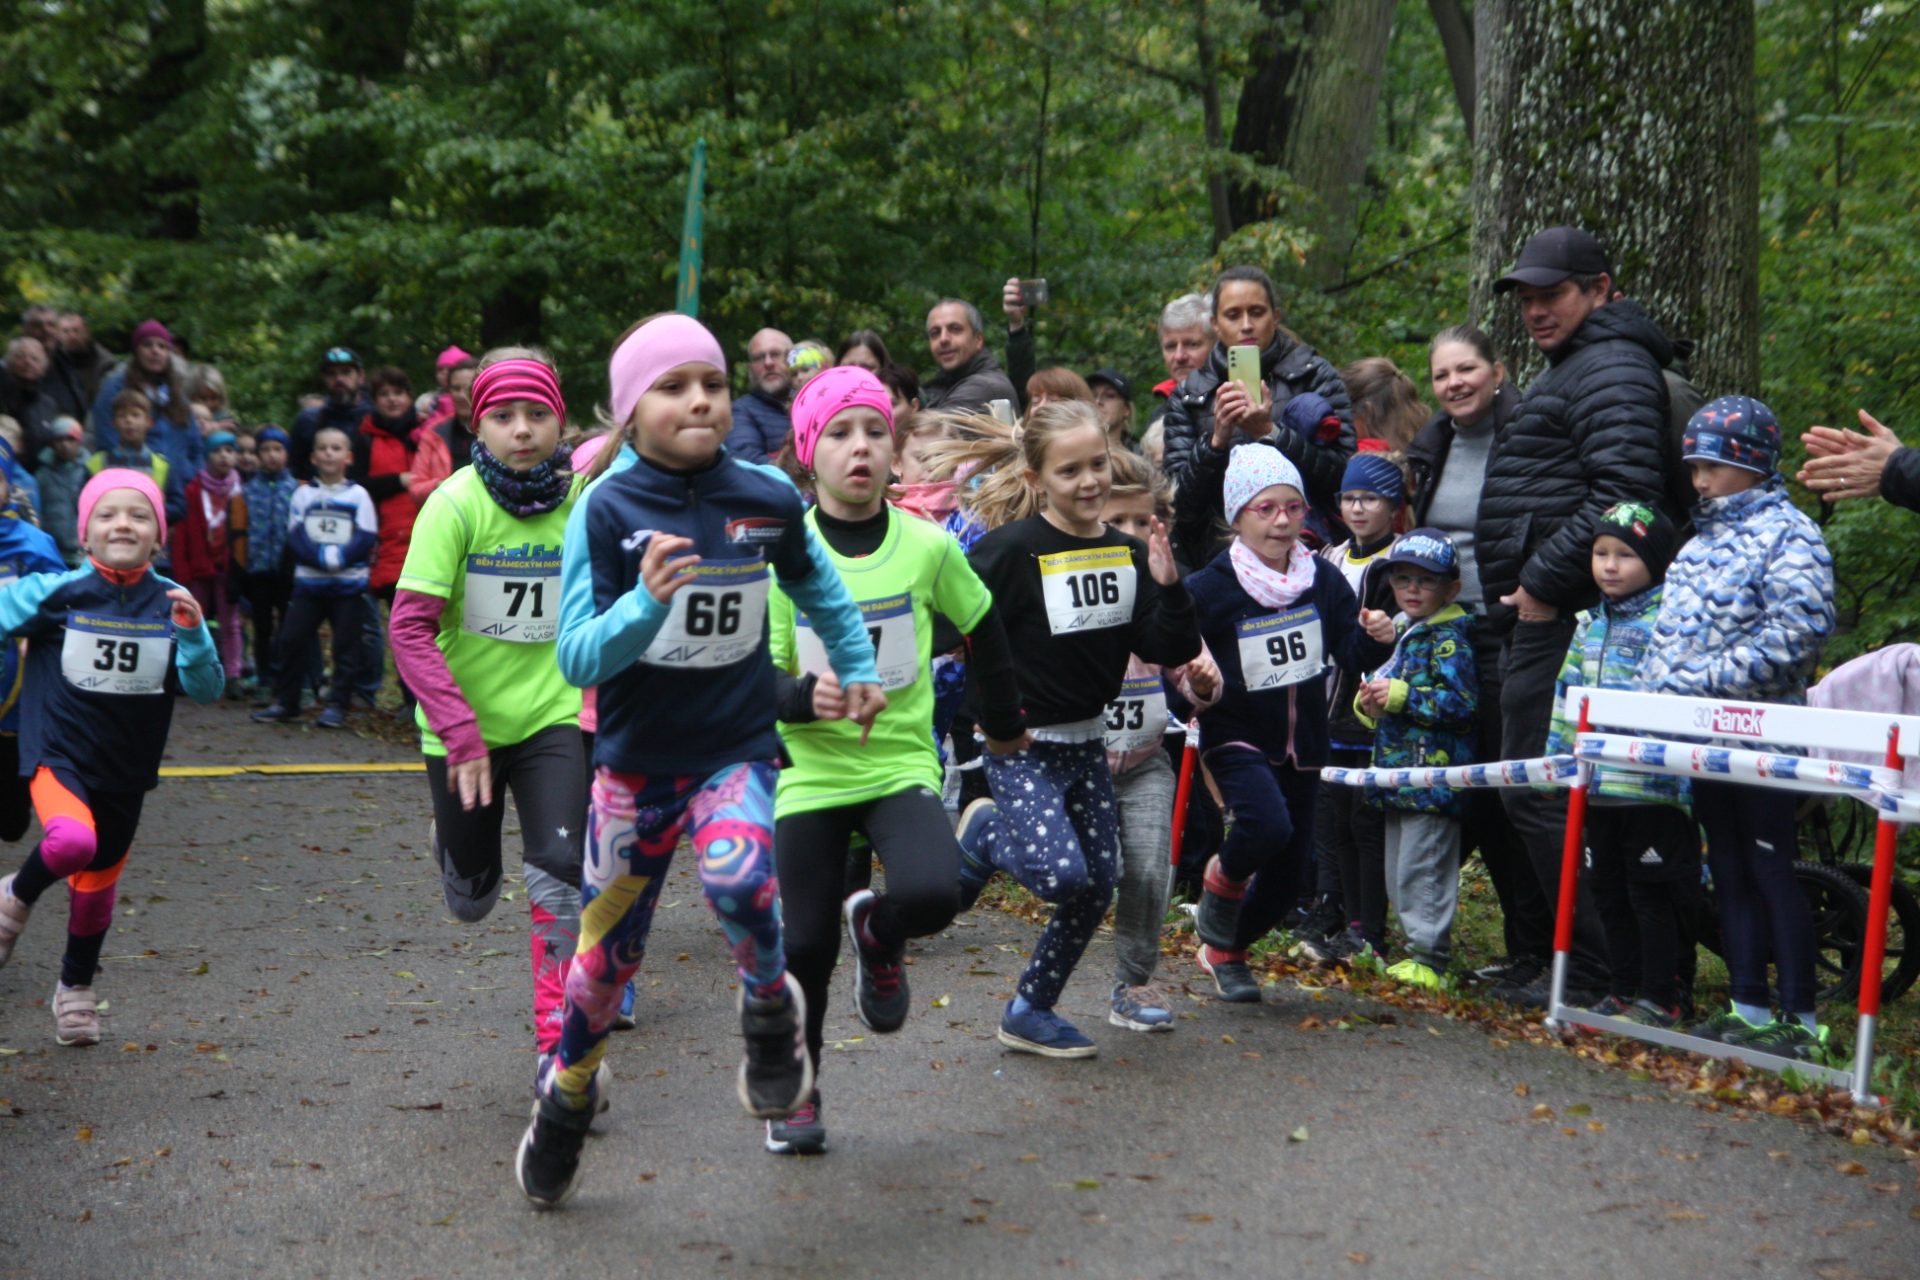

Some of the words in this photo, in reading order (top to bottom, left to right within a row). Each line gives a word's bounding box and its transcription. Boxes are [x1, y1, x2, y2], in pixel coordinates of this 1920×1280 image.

[318, 518, 337, 533] 42
[503, 581, 544, 618] 71
[1065, 571, 1120, 609] 106
[685, 591, 743, 637] 66
[93, 638, 139, 673] 39
[868, 625, 882, 663] 7
[1266, 630, 1307, 667] 96
[1105, 699, 1144, 731] 33
